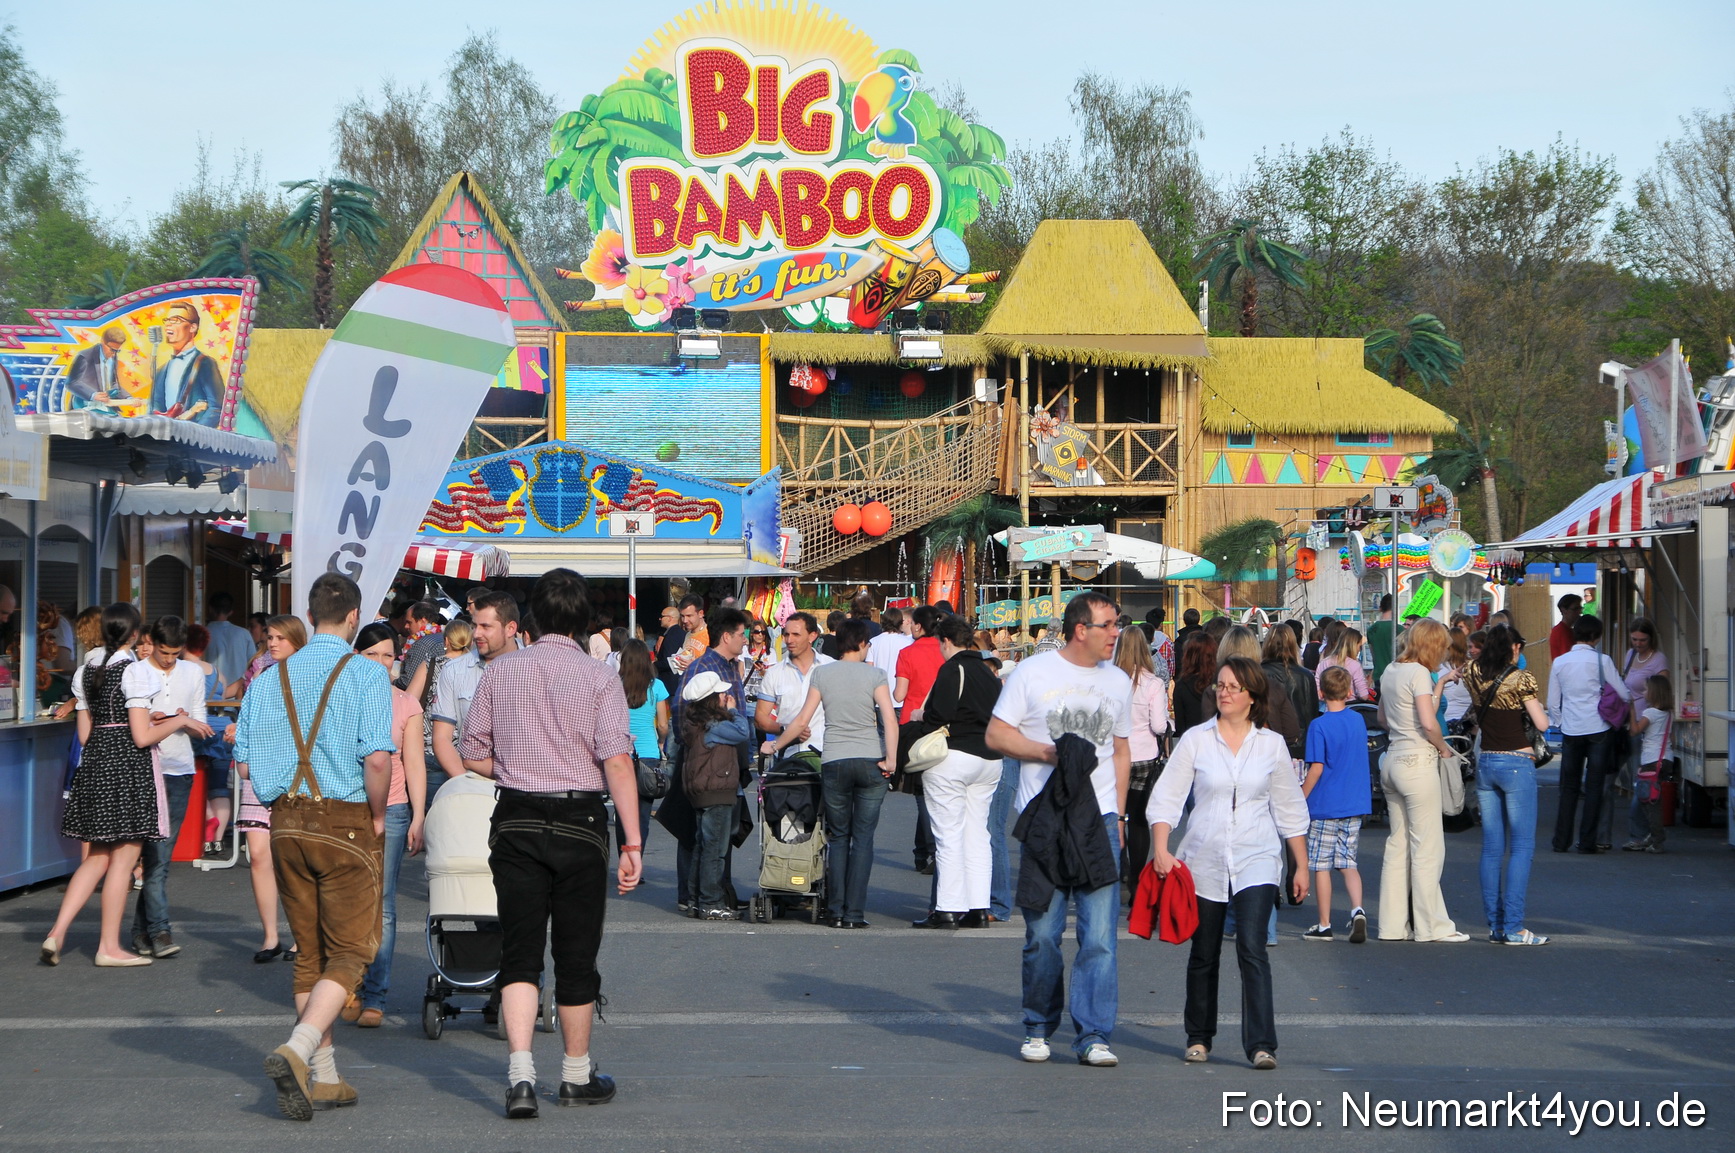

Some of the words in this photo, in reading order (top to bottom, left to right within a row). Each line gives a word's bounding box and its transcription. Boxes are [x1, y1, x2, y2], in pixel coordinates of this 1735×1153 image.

[685, 46, 835, 158] BIG
[626, 164, 933, 259] BAMBOO
[710, 268, 762, 302] it's
[772, 252, 849, 302] fun!
[1062, 425, 1087, 443] STORM
[327, 365, 412, 584] LANG
[1042, 463, 1073, 482] WARNING
[1034, 535, 1066, 548] CUBAN
[1036, 543, 1068, 556] CIGARS
